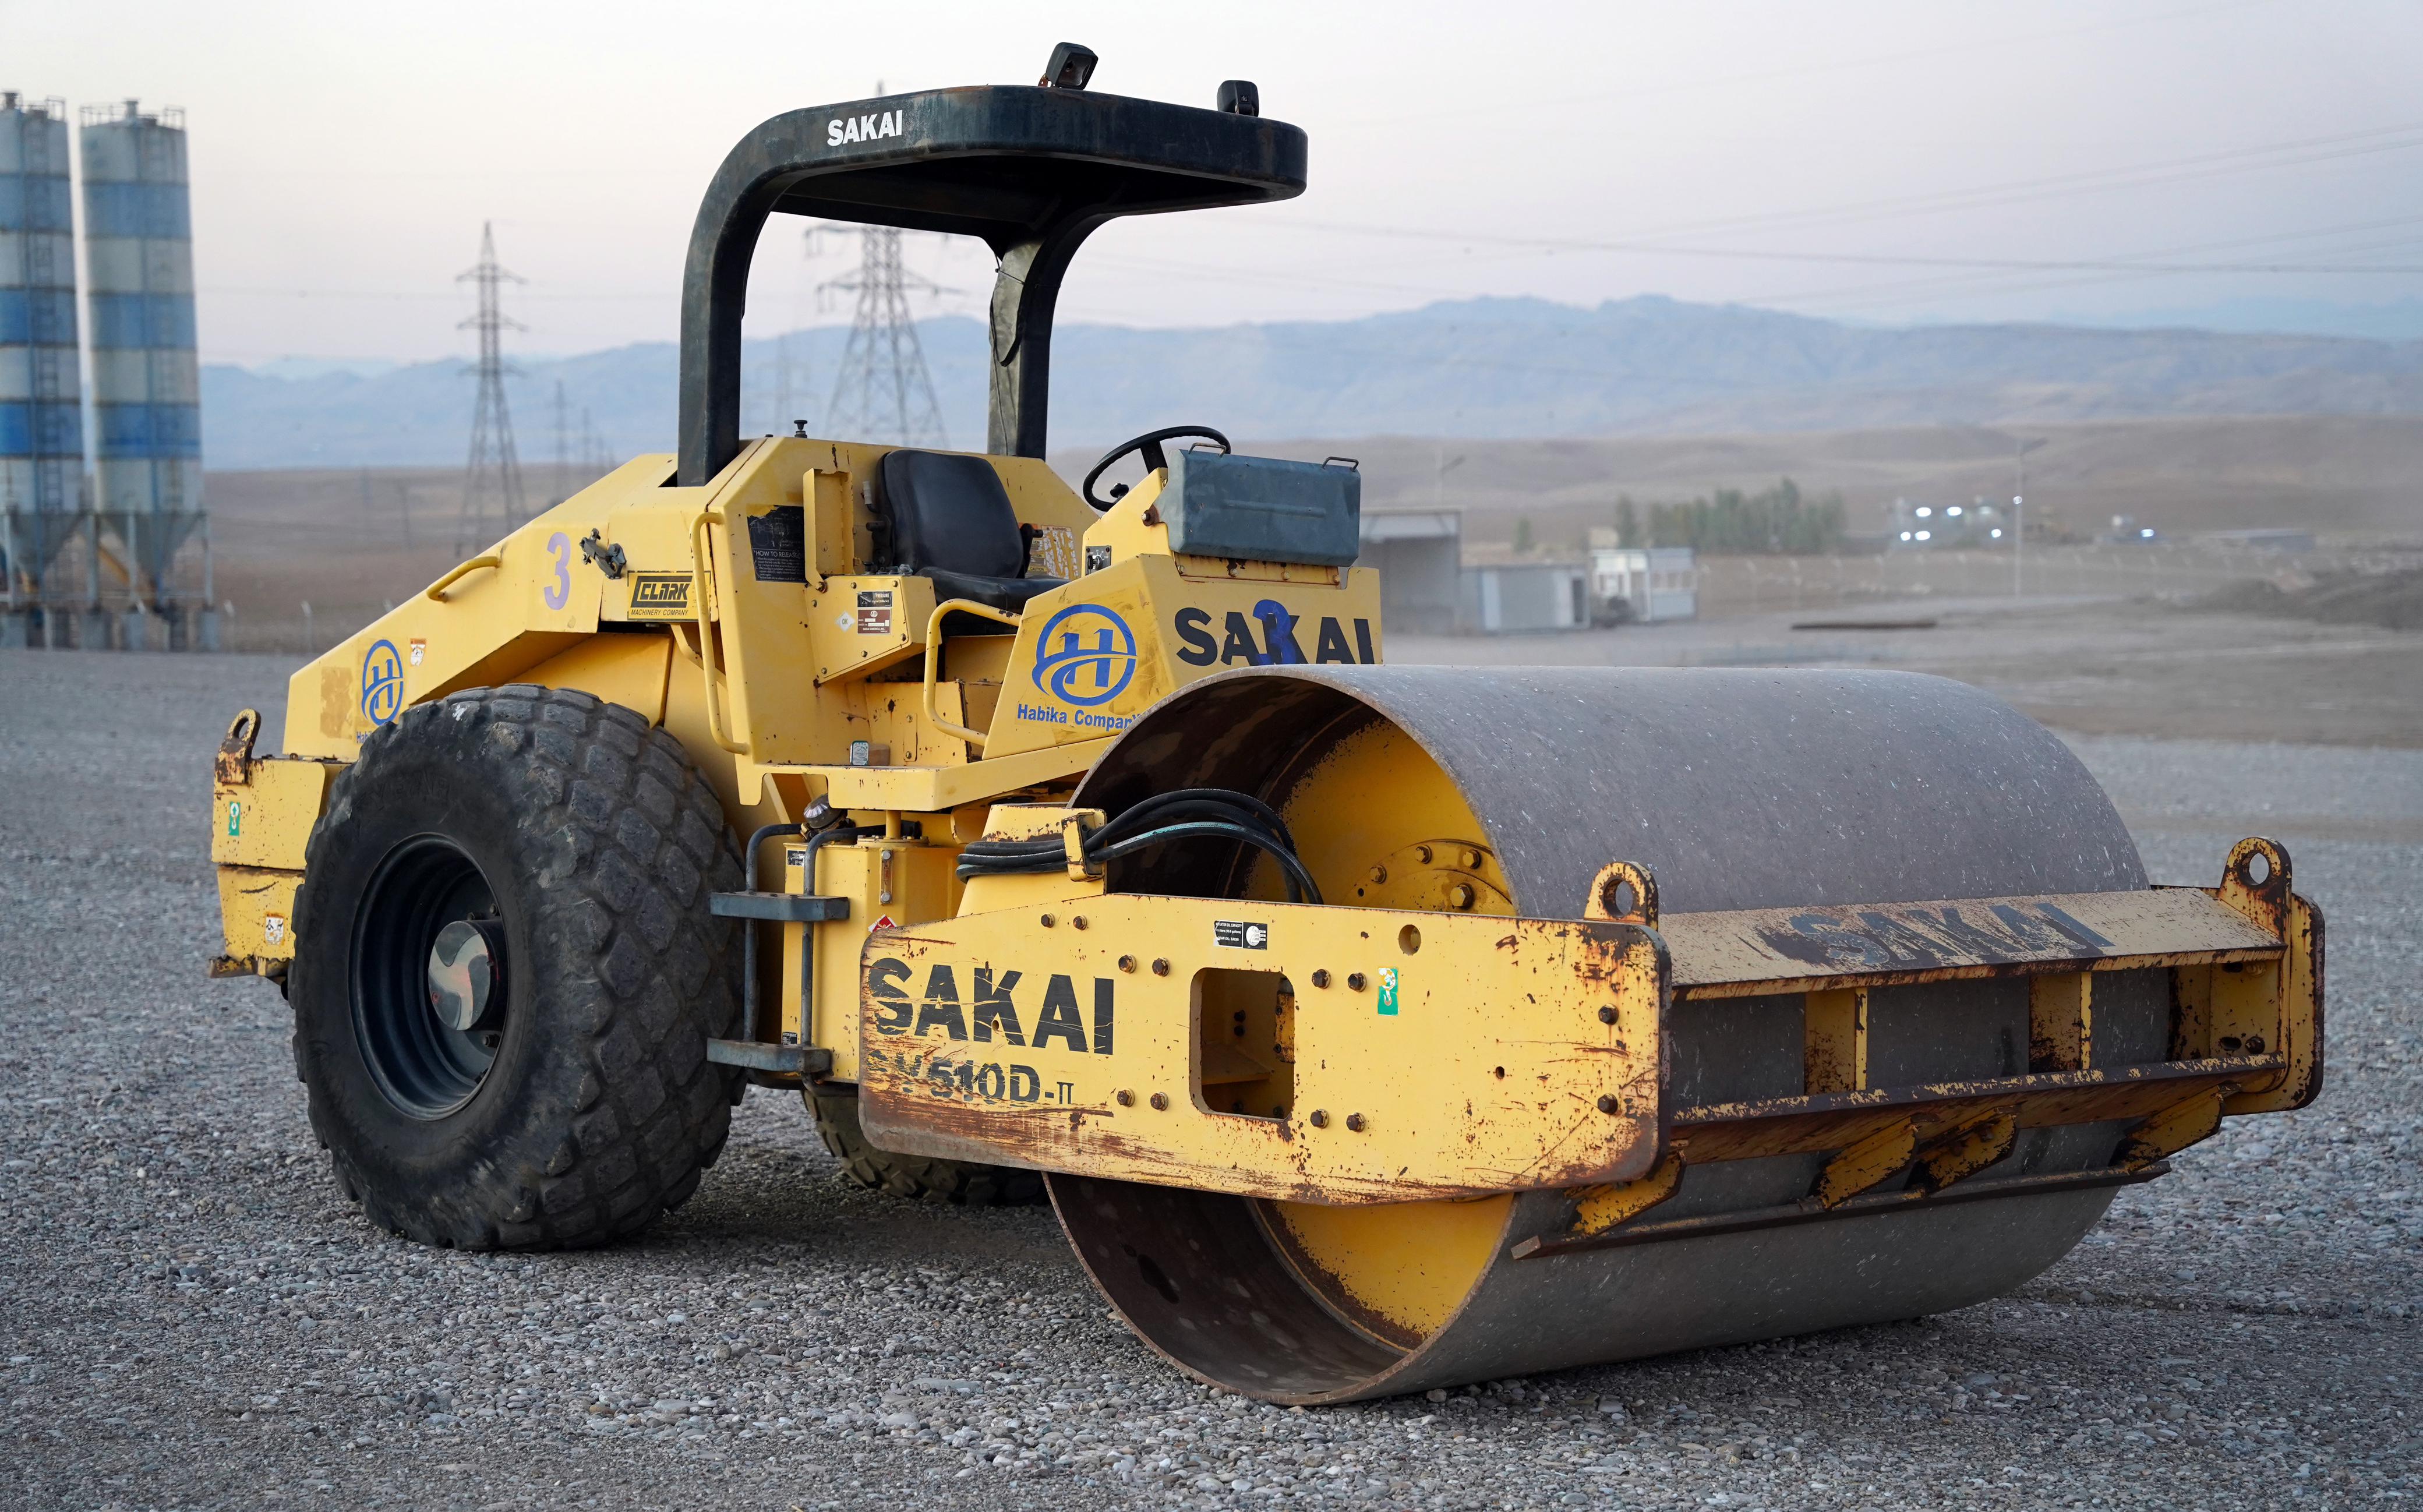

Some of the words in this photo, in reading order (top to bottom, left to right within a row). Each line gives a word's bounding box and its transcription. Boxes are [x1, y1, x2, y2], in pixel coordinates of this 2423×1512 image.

[826, 109, 903, 146] SAKAI
[543, 531, 571, 610] 3
[640, 582, 692, 600] CLARK
[662, 609, 689, 617] COMPANY
[1174, 606, 1375, 666] SAKAI
[1017, 703, 1068, 724] Habika
[1789, 903, 2114, 965] SAKAI
[866, 957, 1114, 1055] SAKAI
